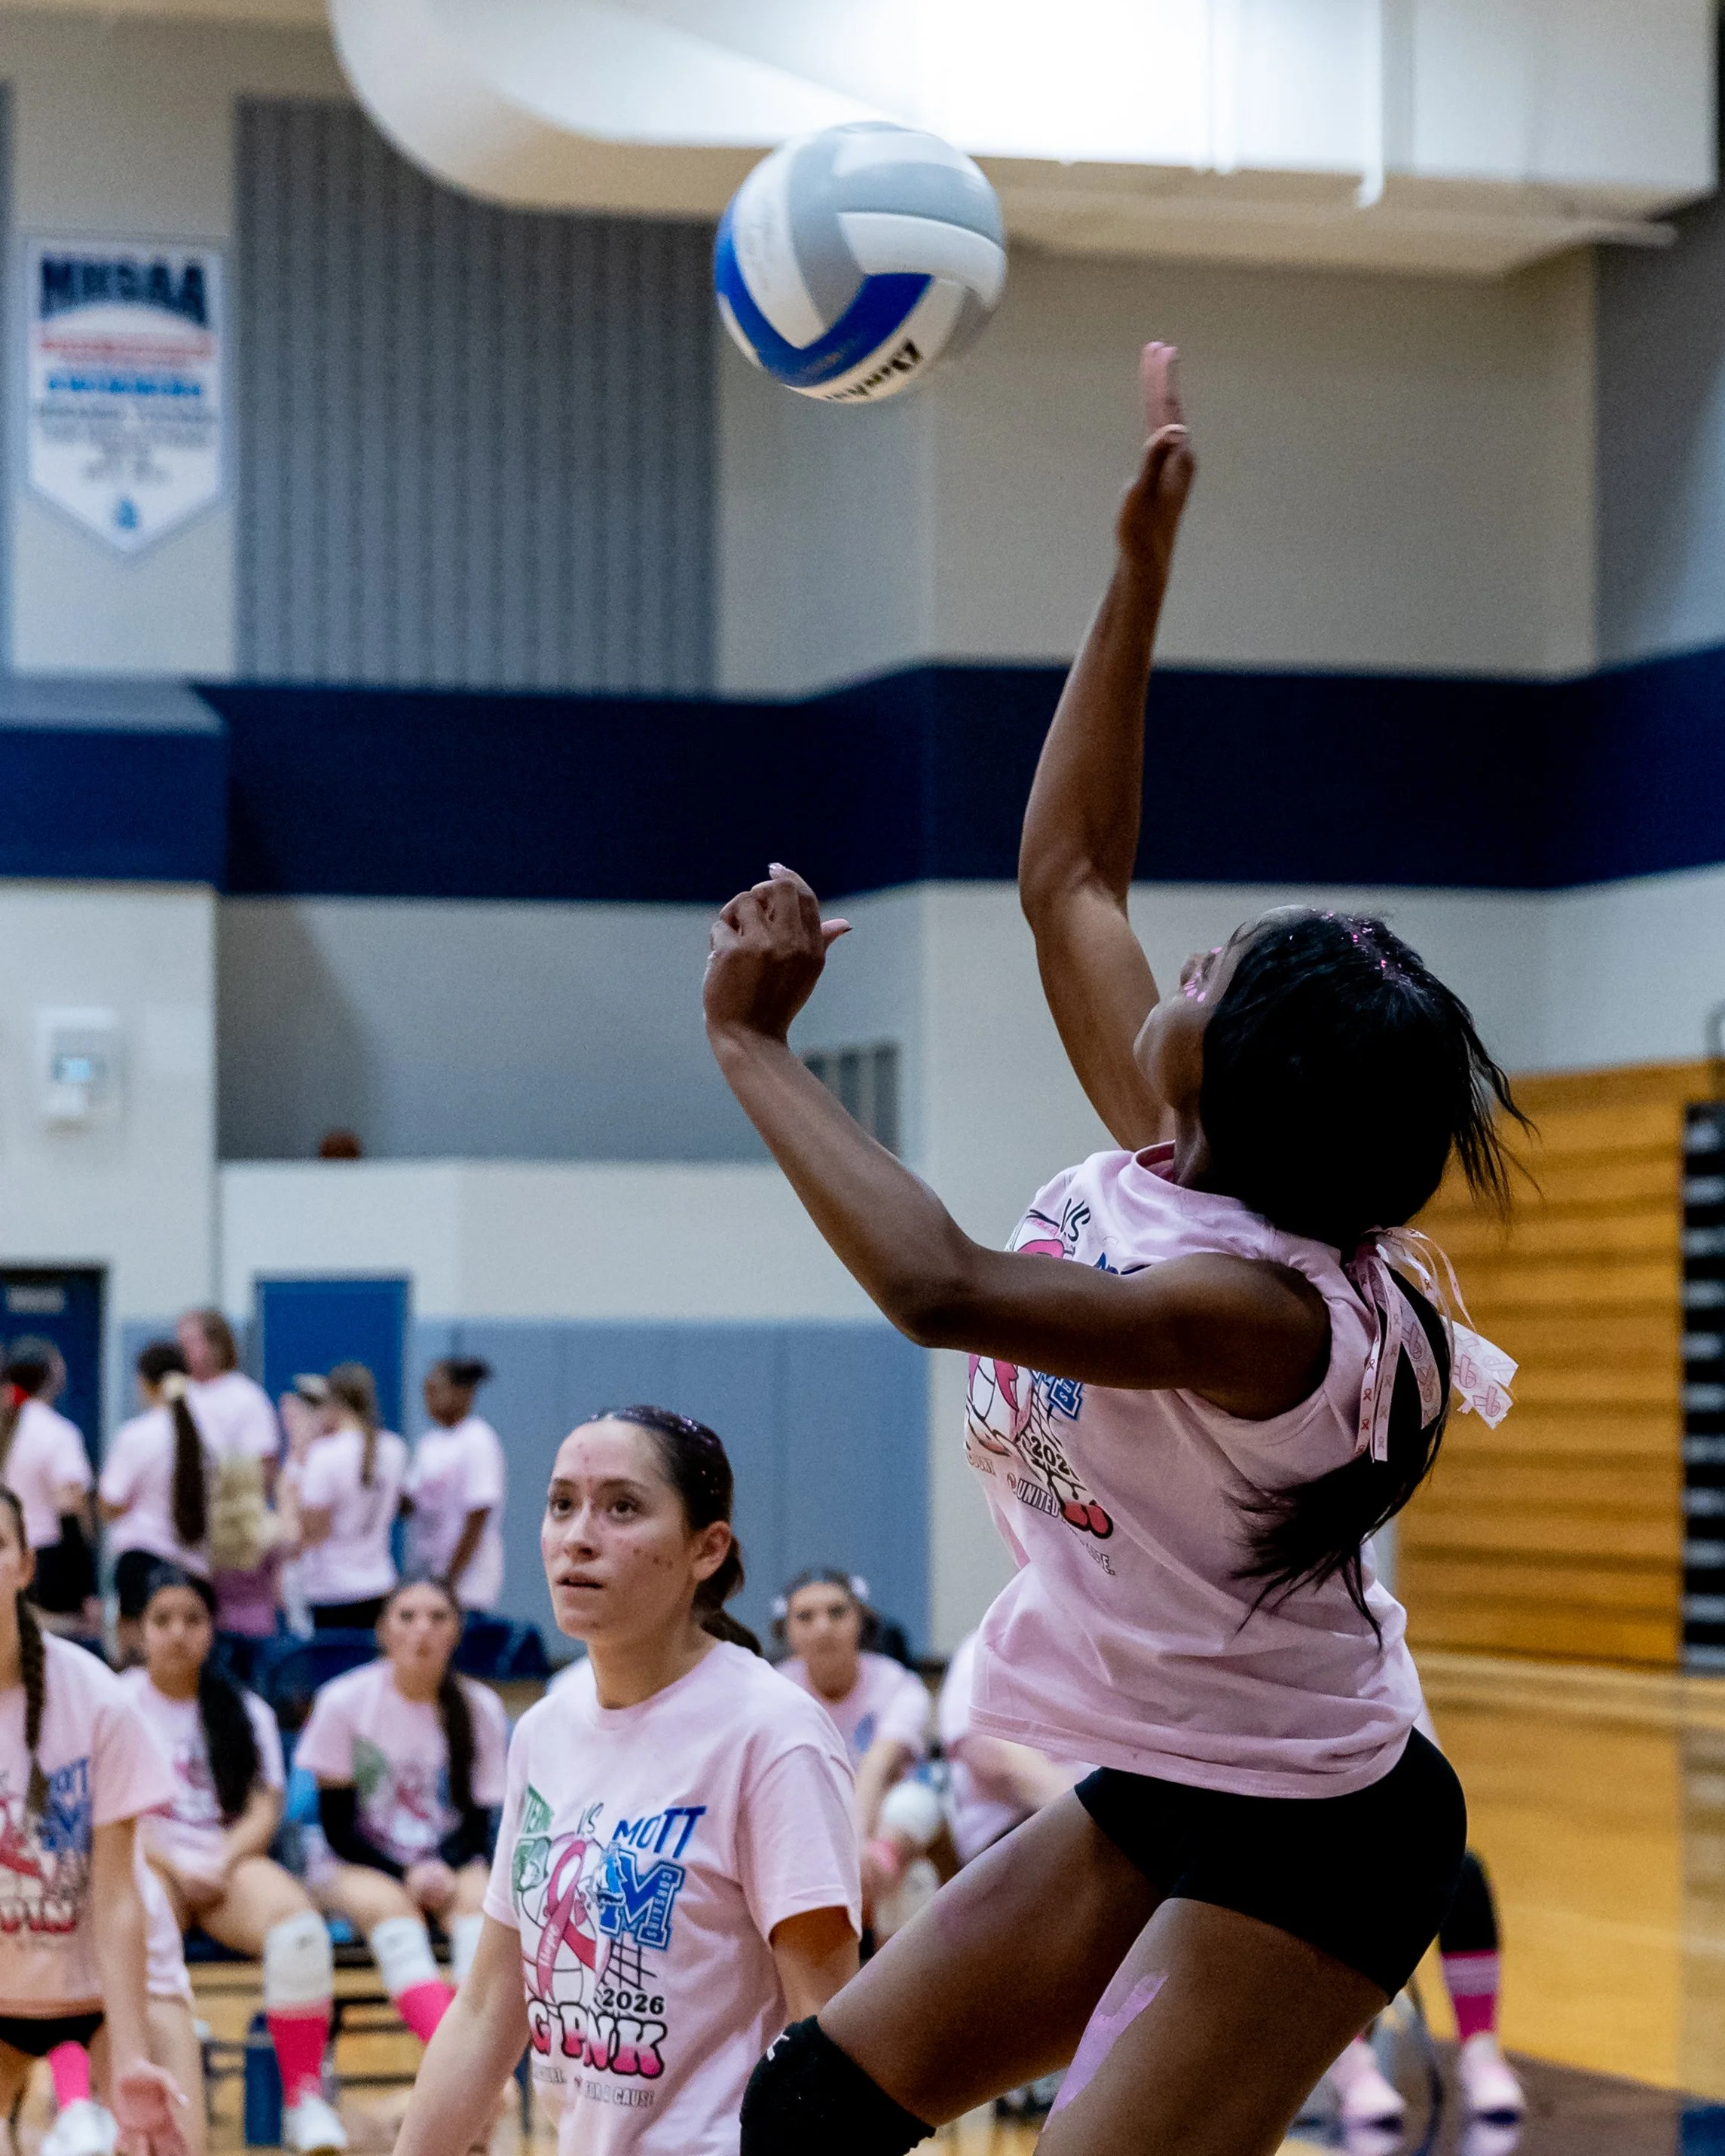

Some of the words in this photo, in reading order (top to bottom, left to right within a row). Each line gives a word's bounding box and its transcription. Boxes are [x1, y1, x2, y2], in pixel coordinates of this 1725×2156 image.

[1030, 1435, 1070, 1476] 202
[1017, 1477, 1059, 1518] UNITED
[612, 1805, 707, 1859] MOTT
[603, 1988, 665, 2015] 2026
